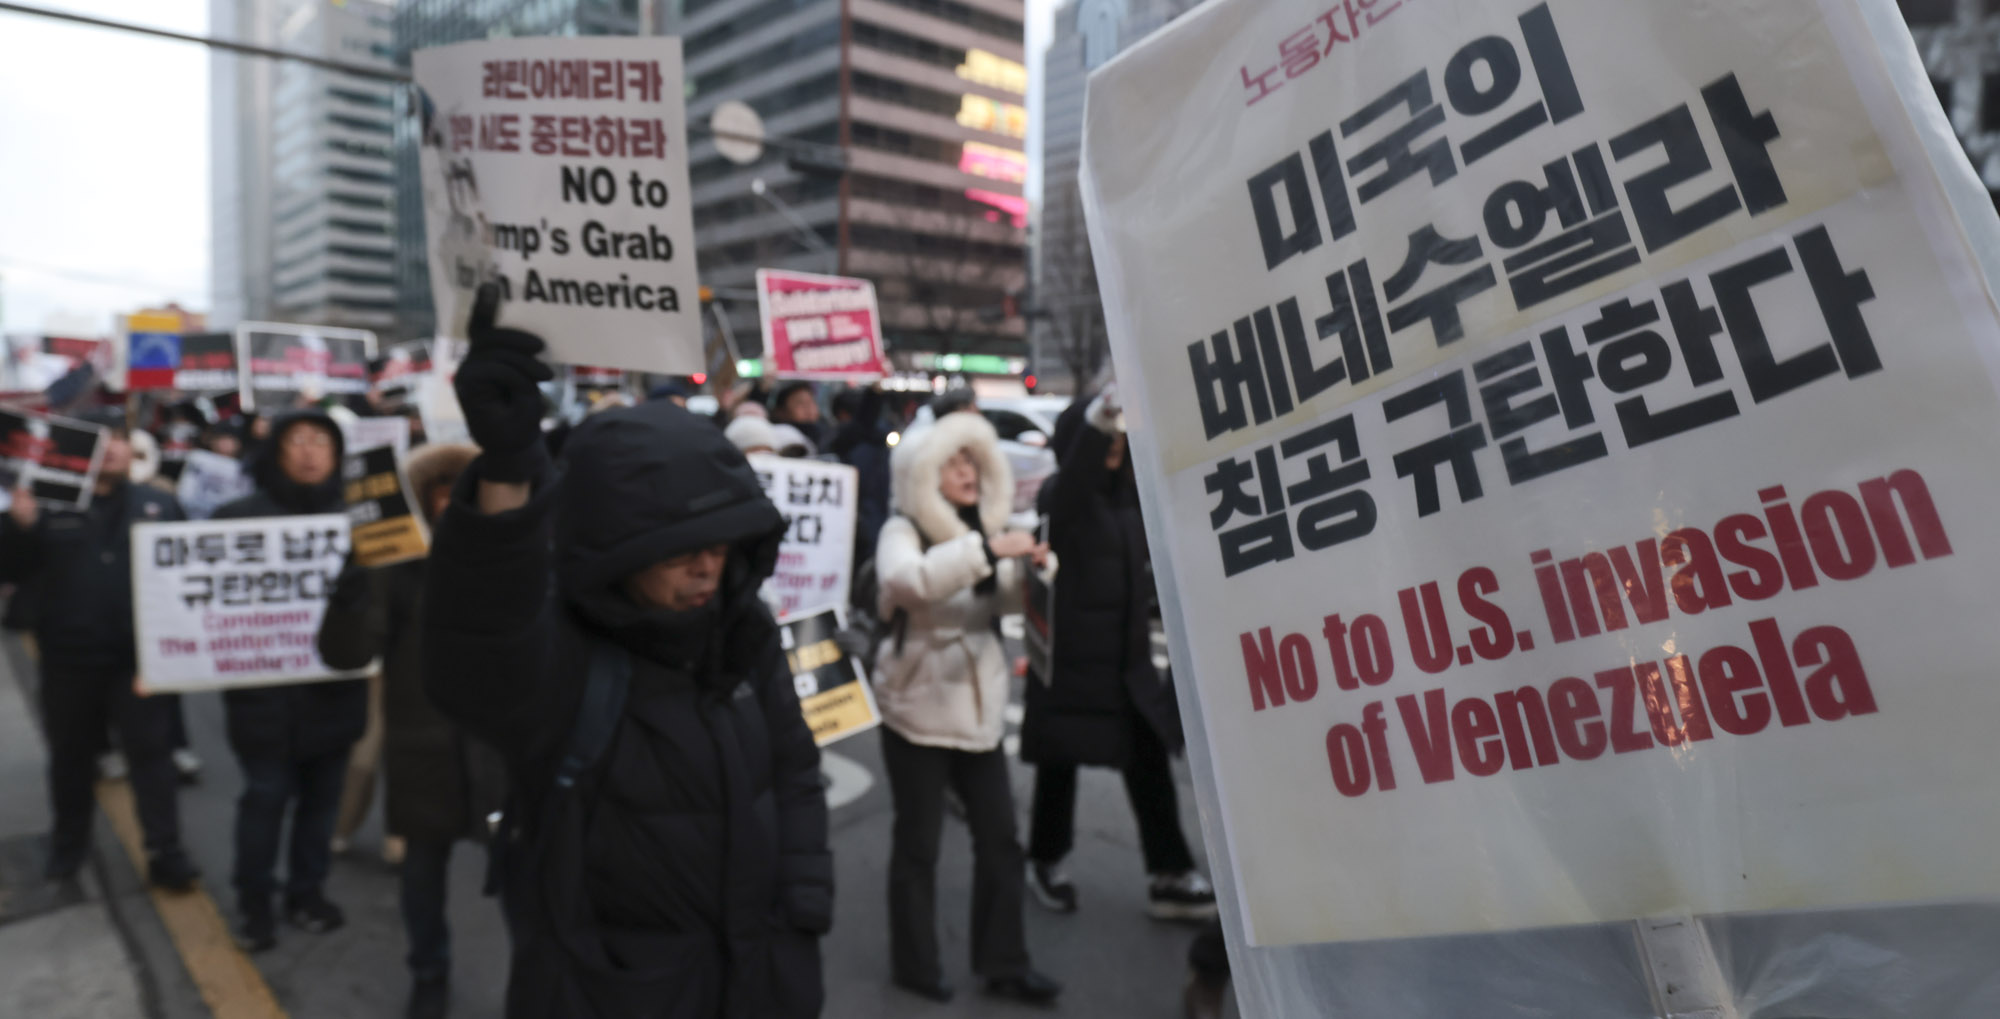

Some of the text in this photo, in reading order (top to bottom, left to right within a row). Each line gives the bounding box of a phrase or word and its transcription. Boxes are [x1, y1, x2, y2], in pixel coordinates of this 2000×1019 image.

[482, 59, 663, 102] 라틴아메리카
[530, 115, 667, 159] 중단하라
[1247, 2, 1586, 272] 미국의
[561, 165, 669, 208] NO to
[487, 217, 674, 262] mp's Grab
[1187, 70, 1790, 441] 베네수엘라
[523, 268, 681, 313] America
[1204, 223, 1885, 578] 침공 규탄한다
[155, 534, 267, 568] 마두로
[1239, 468, 1954, 712] No to U.S. invasion
[1326, 617, 1879, 797] of Venezuela
